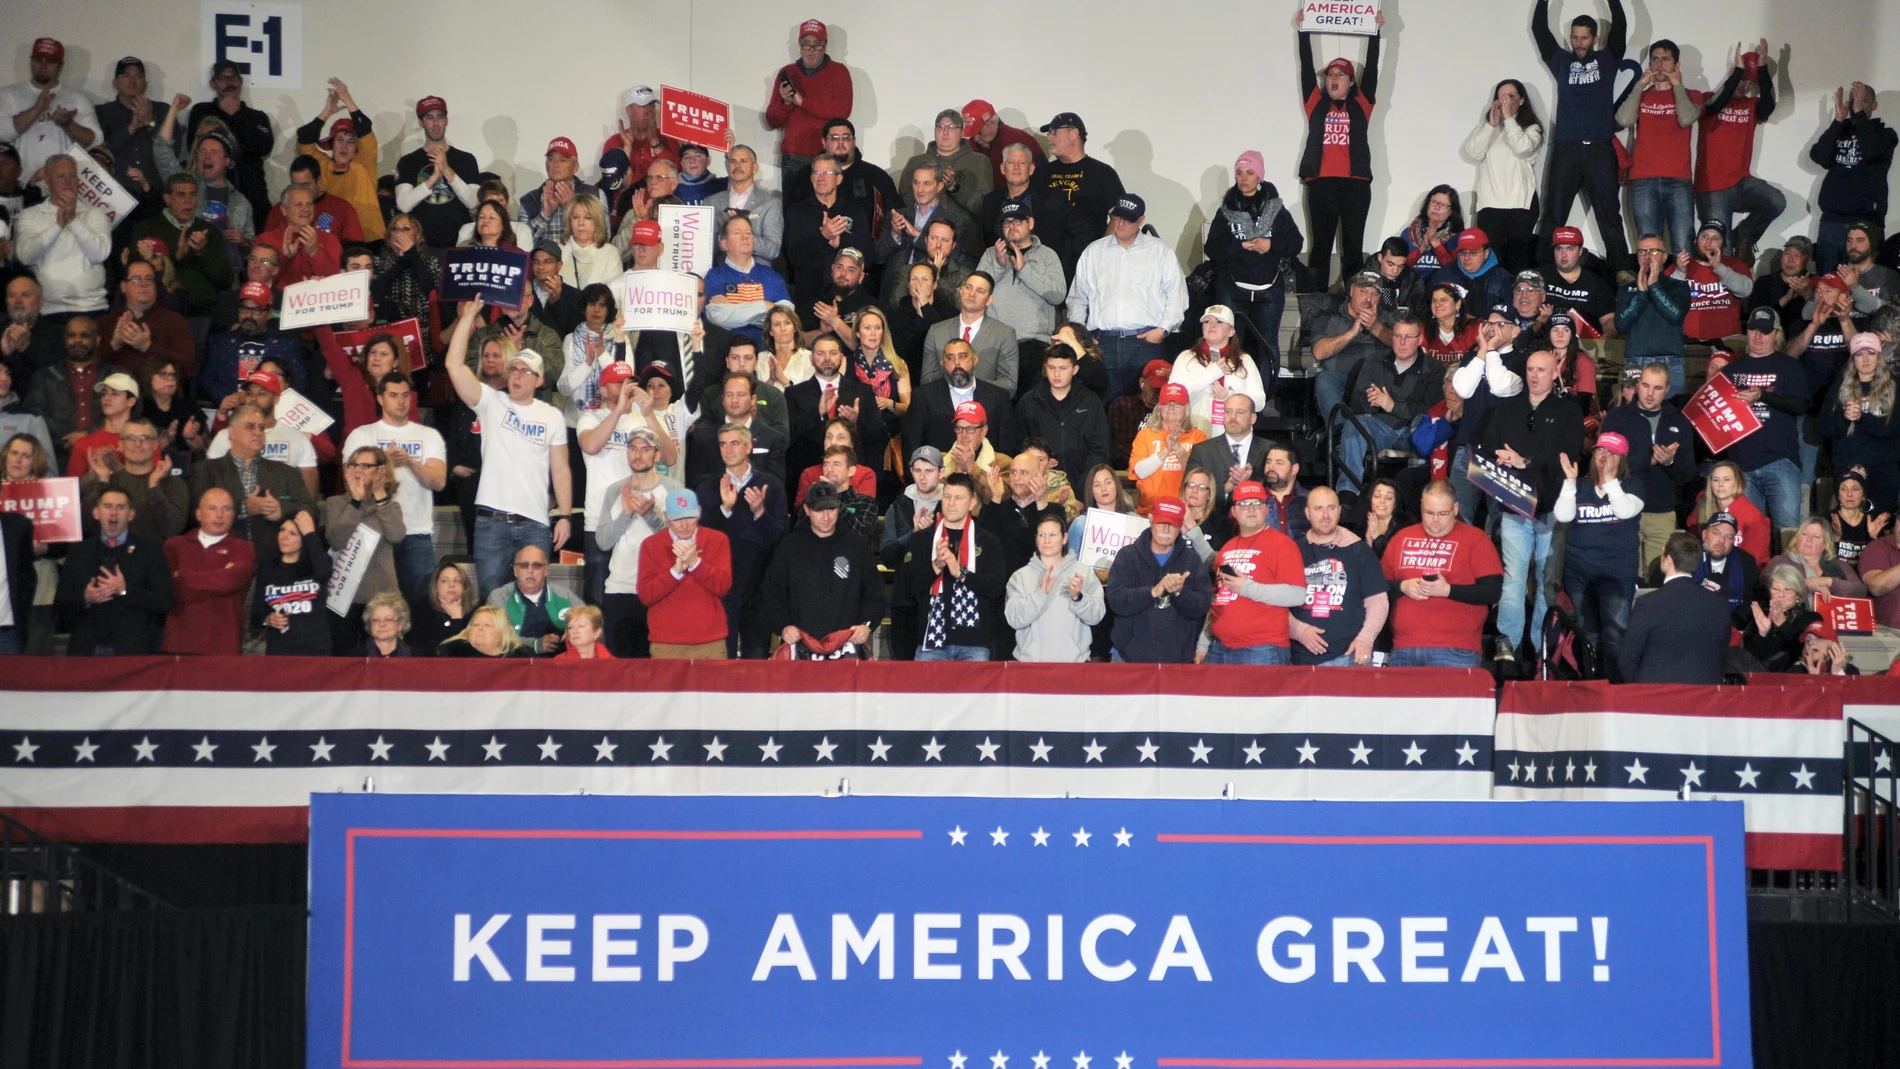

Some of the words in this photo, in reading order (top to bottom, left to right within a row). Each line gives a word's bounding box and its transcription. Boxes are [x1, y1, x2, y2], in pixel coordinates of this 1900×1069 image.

[1306, 3, 1375, 15] AMERICA
[1316, 15, 1364, 26] GREAT!
[666, 100, 725, 124] TRUMP
[671, 112, 720, 131] PENCE
[1325, 124, 1350, 133] RUM
[1323, 134, 1350, 145] 202
[80, 167, 114, 198] KEEP
[77, 182, 117, 222] ERICA
[681, 212, 700, 273] Wome
[448, 262, 521, 278] TRUMP
[453, 273, 513, 286] PENCE
[628, 286, 693, 309] Women
[1547, 284, 1589, 297] TRUMP
[288, 287, 362, 309] Women
[295, 306, 316, 316] FOR
[319, 302, 354, 312] TRUMP
[633, 307, 653, 315] FOR
[656, 307, 688, 316] TRUMP
[1813, 334, 1844, 345] RUM
[1732, 373, 1777, 386] TRUMP
[1699, 394, 1731, 433] PENCE
[1704, 384, 1745, 432] TRUMP
[294, 416, 311, 431] UMP
[260, 443, 288, 457] UMP
[377, 441, 421, 455] TRMP
[1475, 454, 1532, 492] TRUMP
[1480, 464, 1527, 497] PENCE
[0, 496, 69, 512] RUMP
[1578, 504, 1615, 518] TRUM
[26, 509, 64, 520] NCE
[1091, 524, 1137, 548] Wom
[1095, 546, 1117, 557] FOR
[1407, 541, 1453, 551] LATINOS
[1838, 549, 1858, 559] RUMP
[335, 576, 348, 597] FOR
[344, 539, 362, 573] TRUMP
[1233, 562, 1257, 574] UMP
[1403, 556, 1448, 568] TRUMP
[264, 581, 321, 596] Trump
[1306, 584, 1324, 594] ET
[1325, 584, 1347, 596] ON
[1836, 606, 1845, 630] PEN
[1844, 602, 1858, 630] TRU
[453, 913, 710, 982] KEEP
[751, 913, 1213, 982] AMERICA
[1256, 915, 1610, 983] GREAT!
